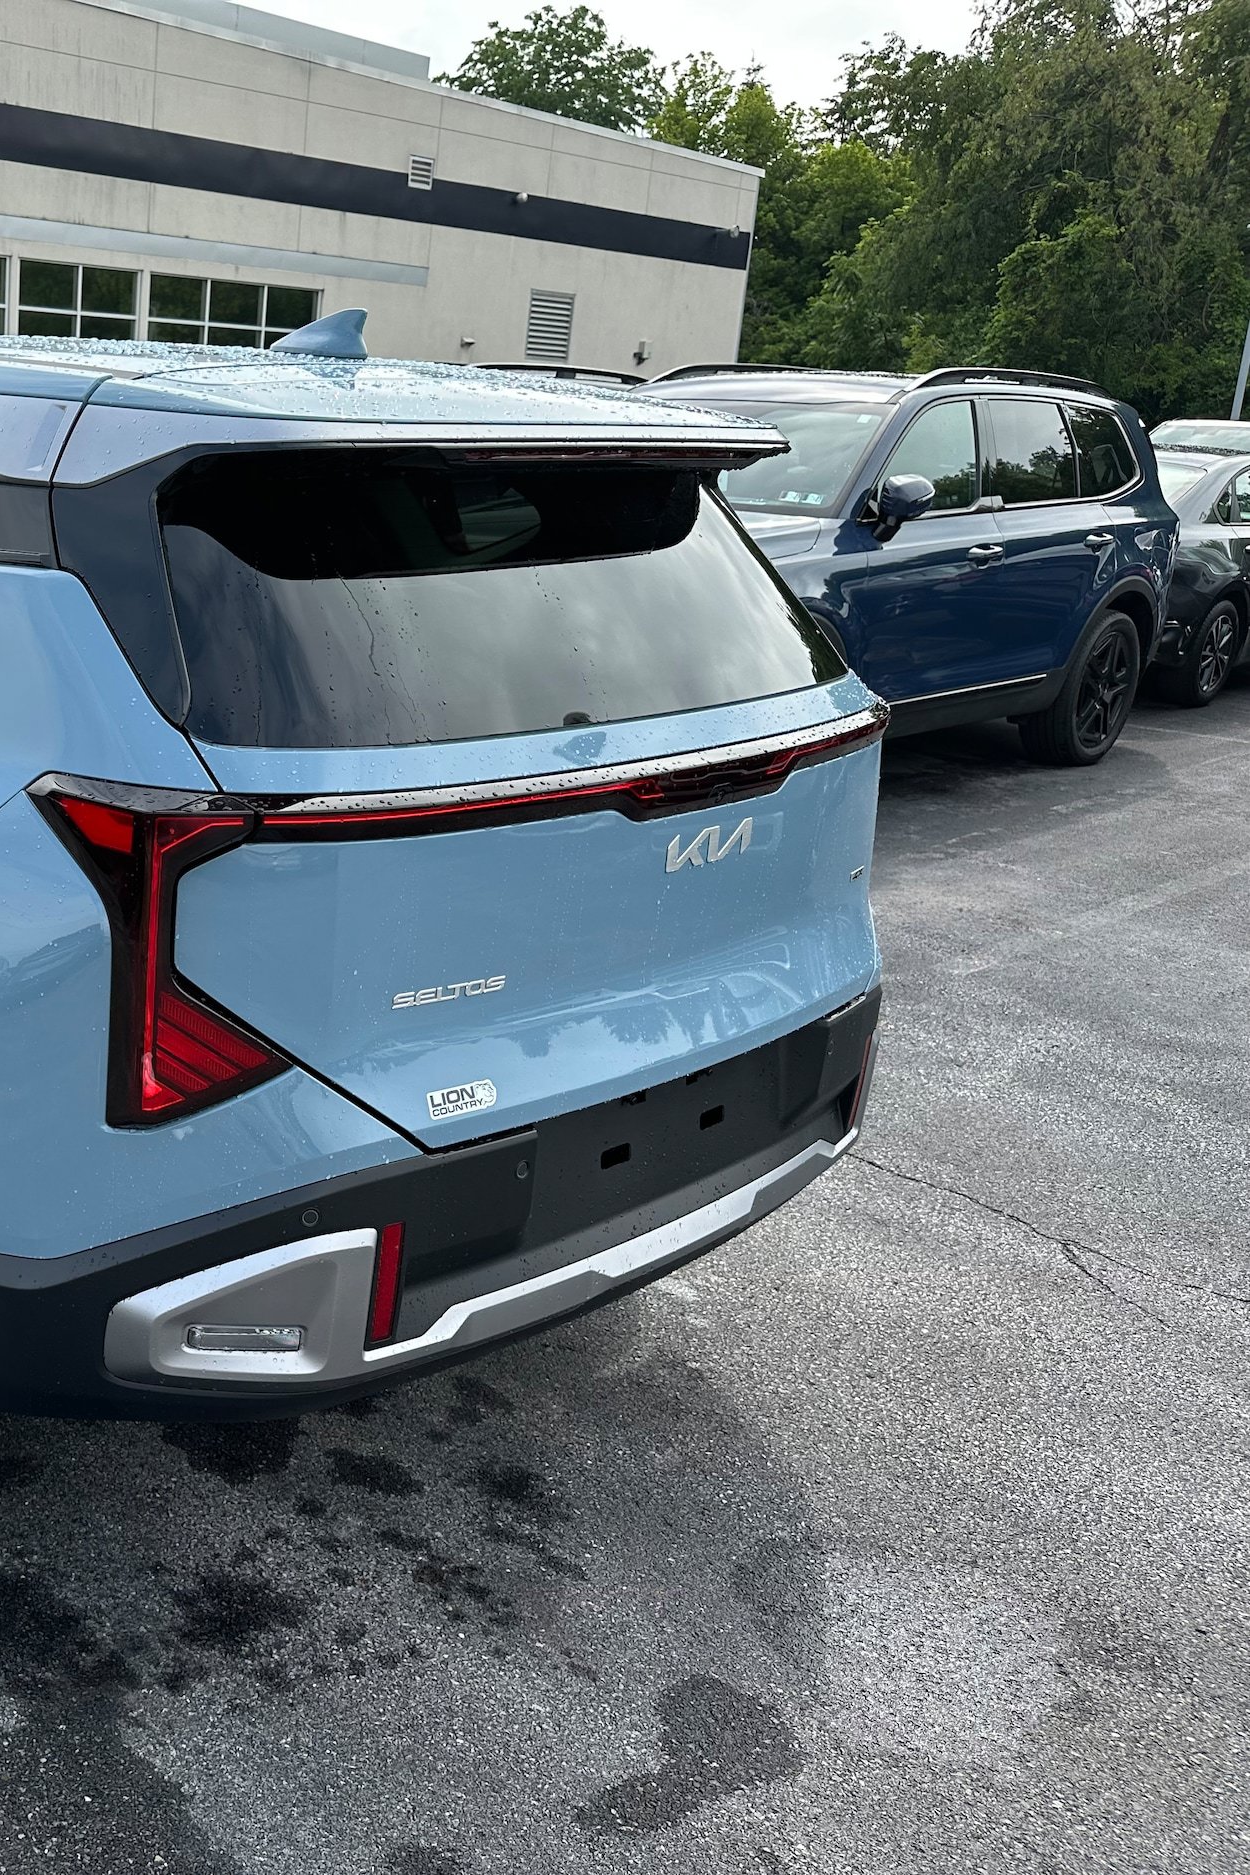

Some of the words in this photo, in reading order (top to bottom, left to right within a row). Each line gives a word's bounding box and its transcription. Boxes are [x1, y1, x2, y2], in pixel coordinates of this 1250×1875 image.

[665, 816, 754, 873] KIA
[391, 974, 507, 1010] SELTOS
[429, 1085, 477, 1109] LION
[431, 1097, 485, 1118] COUNTRY
